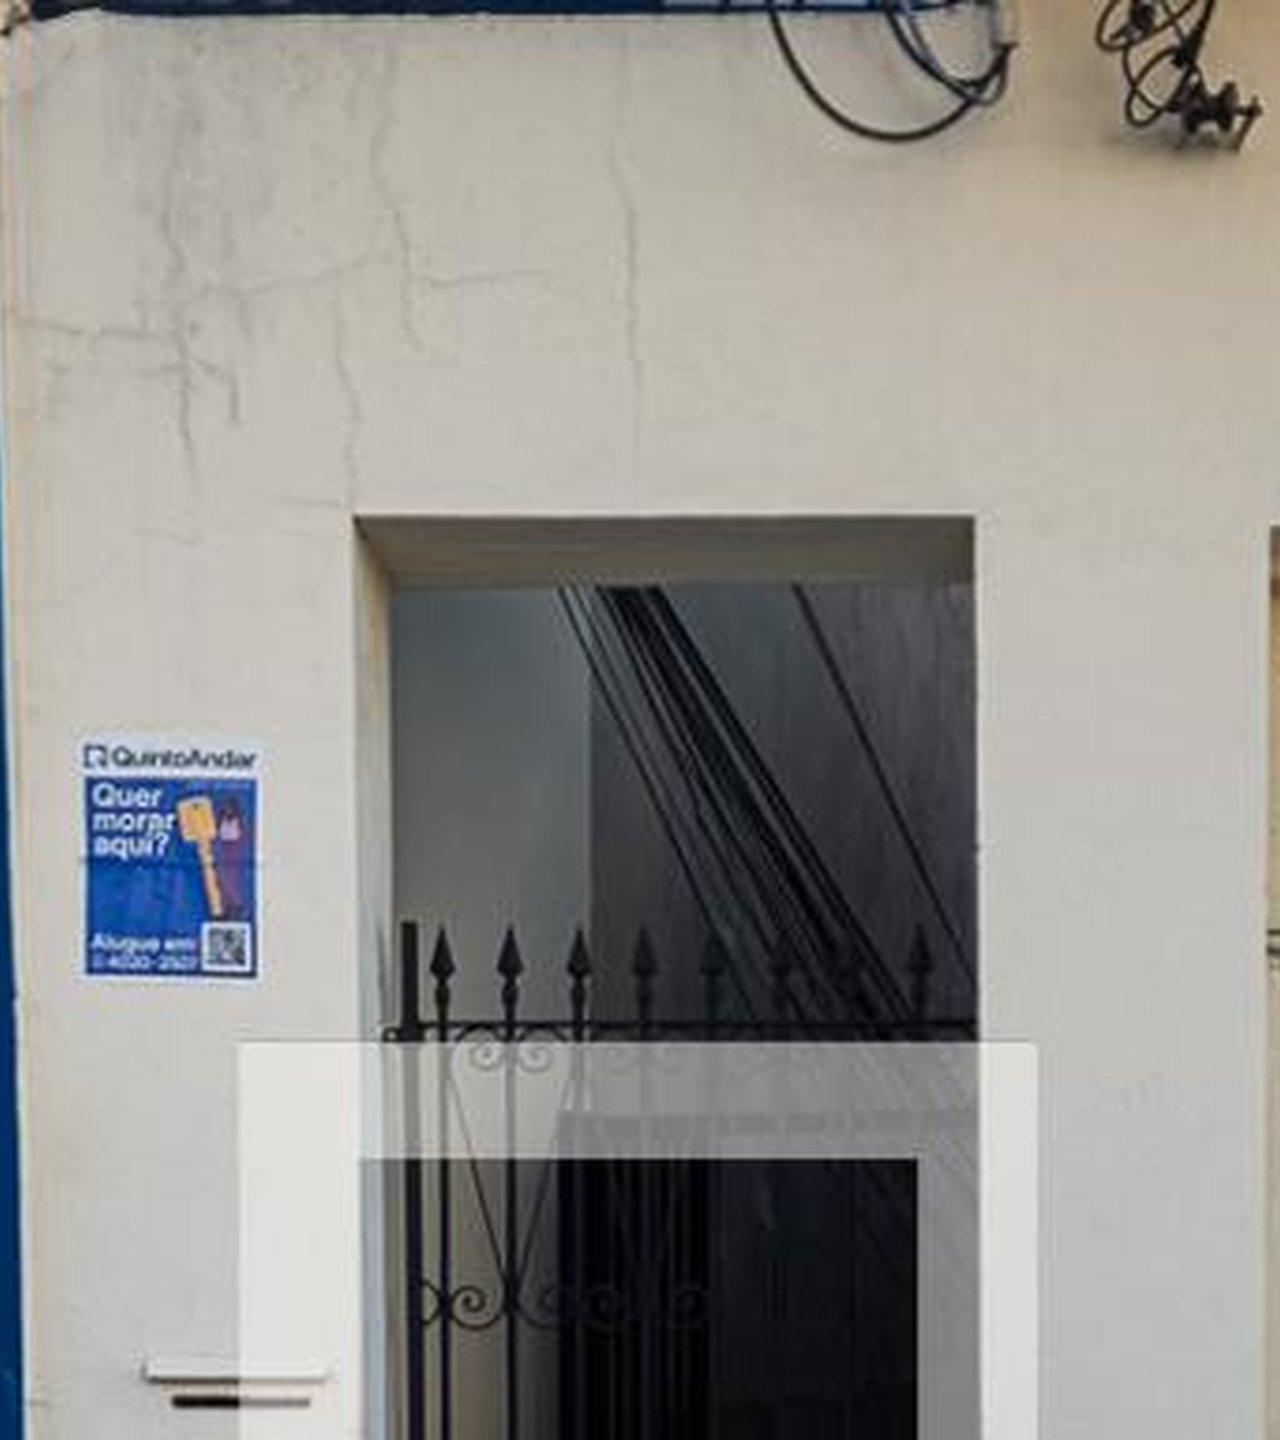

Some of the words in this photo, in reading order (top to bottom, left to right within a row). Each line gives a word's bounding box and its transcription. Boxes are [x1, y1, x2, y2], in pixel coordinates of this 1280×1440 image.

[112, 746, 255, 768] QuintoAndar
[91, 782, 162, 807] Quer
[92, 812, 175, 831] morar
[92, 834, 169, 861] aqui?
[91, 932, 160, 955] Alugue
